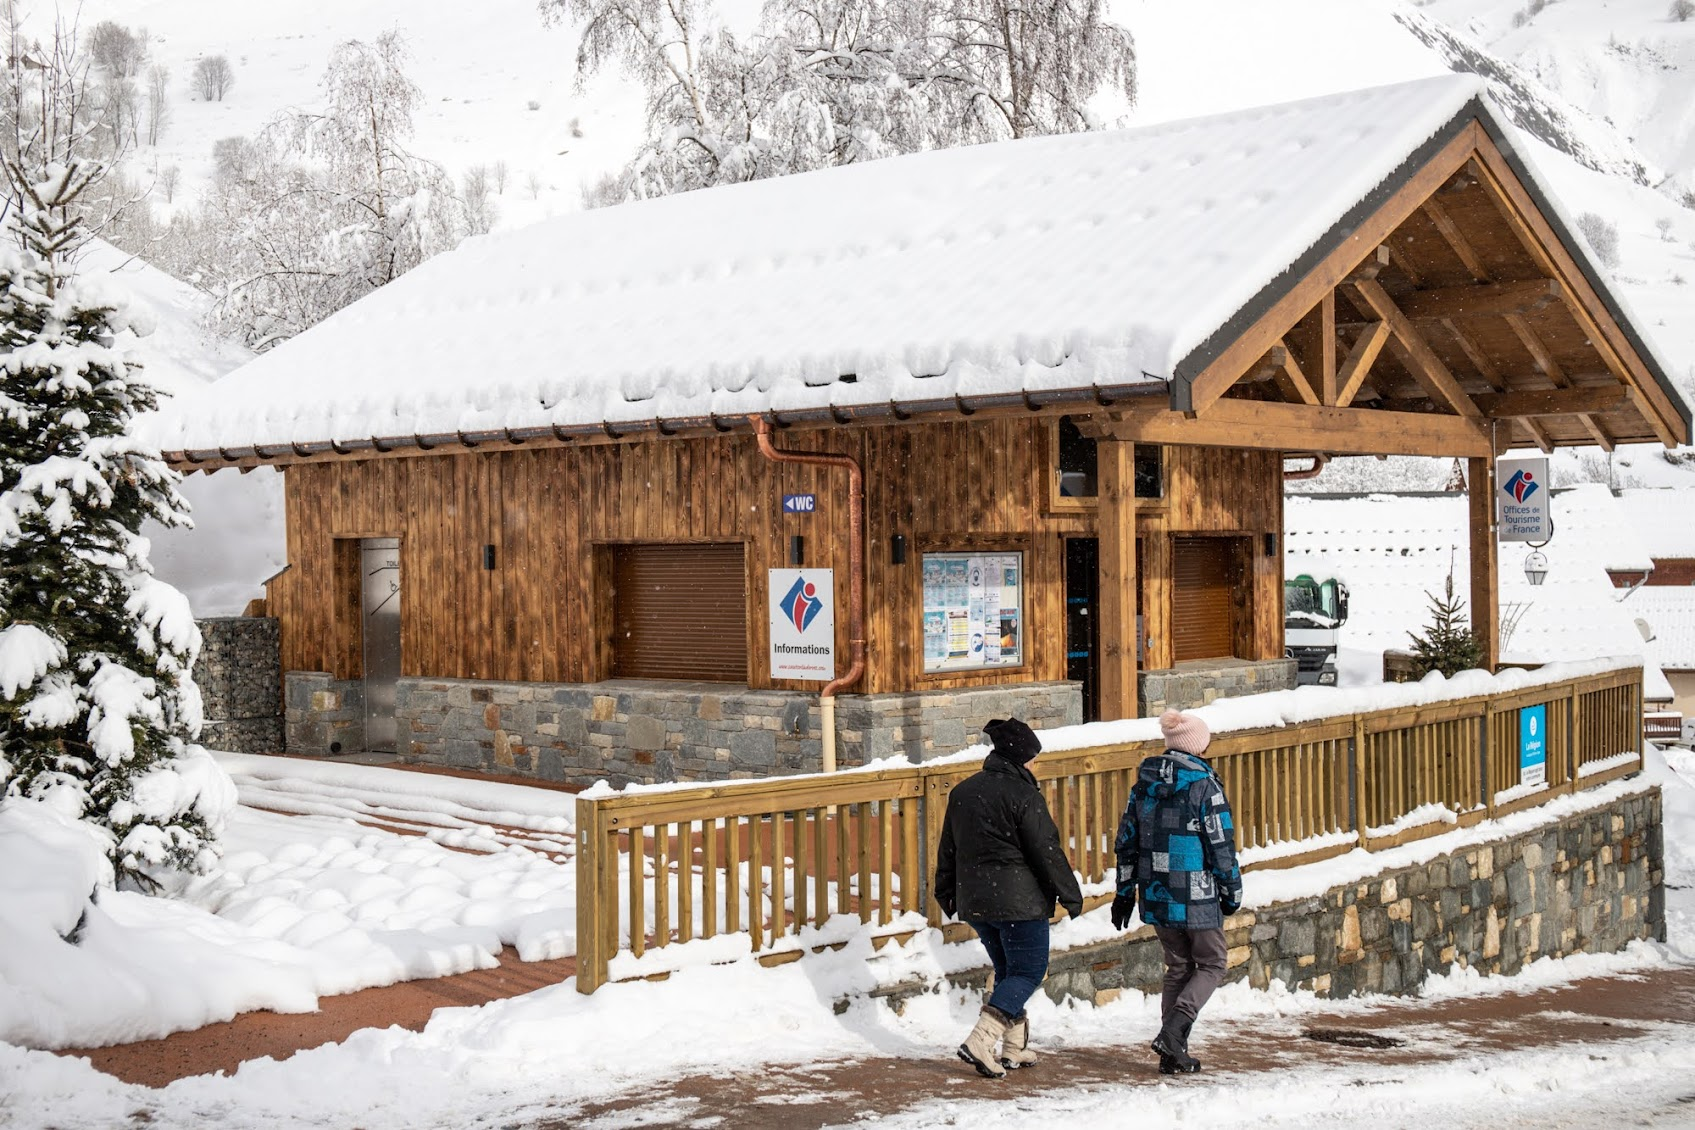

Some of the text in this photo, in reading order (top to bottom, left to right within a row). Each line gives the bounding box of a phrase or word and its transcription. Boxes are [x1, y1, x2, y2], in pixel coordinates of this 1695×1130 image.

[795, 496, 813, 510] WC
[1503, 506, 1530, 514] Offices
[1504, 515, 1540, 524] Tourisme
[1513, 525, 1540, 534] France
[774, 643, 830, 655] Informations
